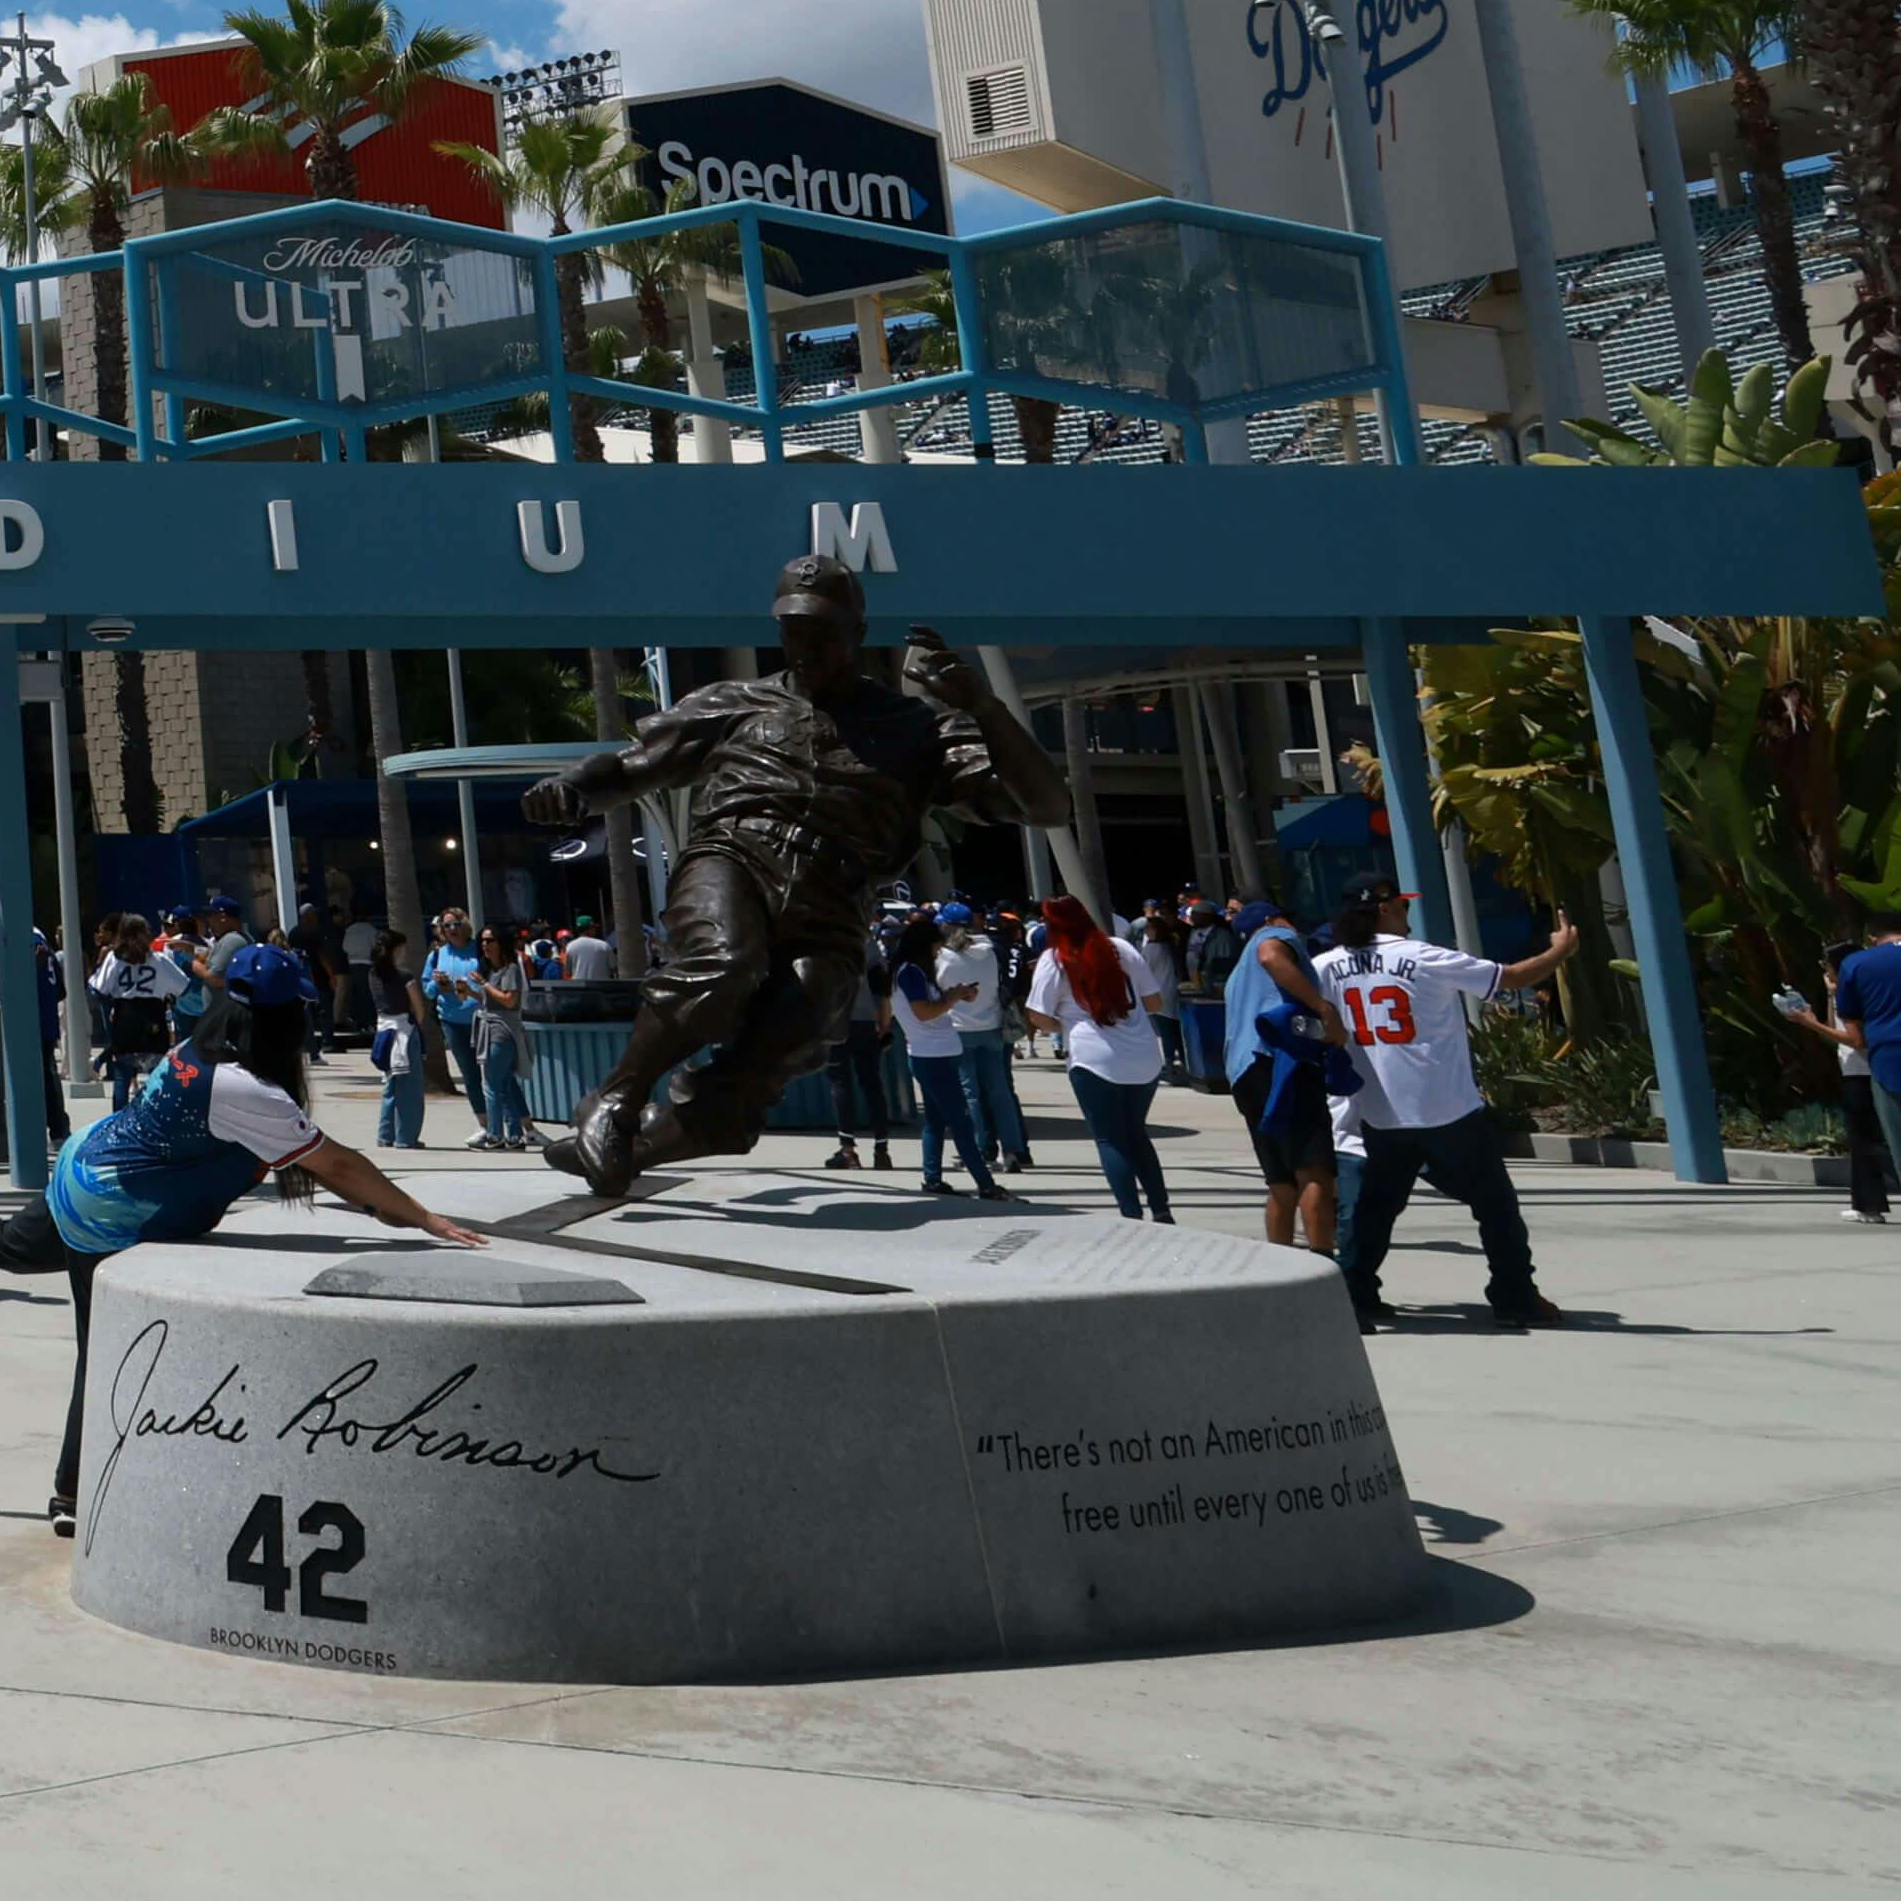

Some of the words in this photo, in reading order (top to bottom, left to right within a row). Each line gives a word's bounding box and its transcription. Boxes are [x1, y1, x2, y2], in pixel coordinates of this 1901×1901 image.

[658, 139, 913, 221] Spectrum
[263, 233, 418, 272] Michelob
[234, 281, 456, 328] ULTRA
[118, 965, 156, 994] 42
[1343, 985, 1417, 1045] 13
[85, 1319, 248, 1559] Jackie
[277, 1359, 660, 1482] Robinson
[1109, 1435, 1152, 1463] not
[1161, 1434, 1196, 1460] an
[1205, 1417, 1325, 1455] American
[1328, 1410, 1347, 1442] in
[1348, 1400, 1373, 1437] this
[1062, 1492, 1119, 1534] free
[1129, 1483, 1185, 1528] until
[1194, 1491, 1267, 1527] every
[1276, 1485, 1323, 1514] one
[1331, 1465, 1352, 1507] of
[1356, 1476, 1375, 1503] us
[1374, 1463, 1388, 1497] is
[226, 1493, 368, 1624] 42
[210, 1627, 298, 1656] BROOKLYN
[305, 1642, 397, 1670] DODGERS
